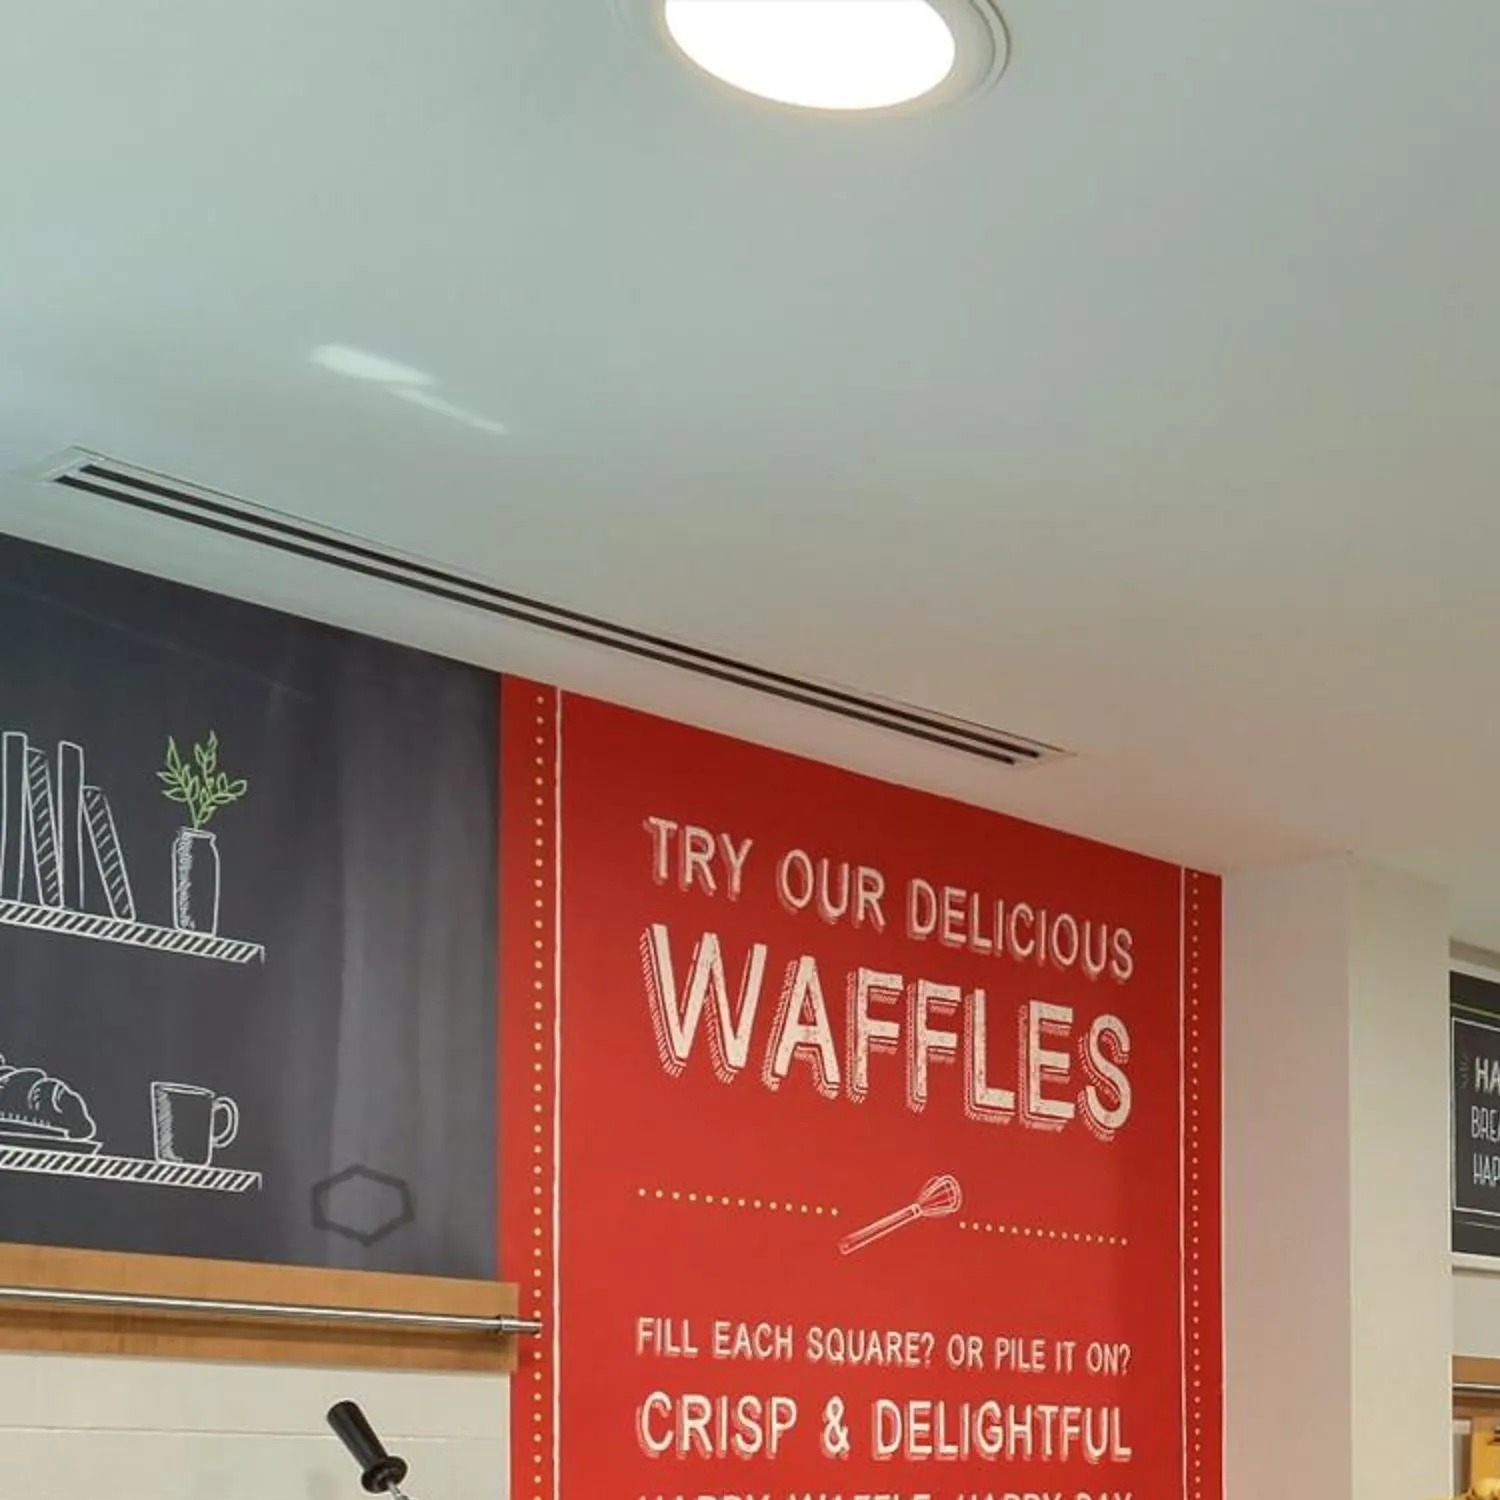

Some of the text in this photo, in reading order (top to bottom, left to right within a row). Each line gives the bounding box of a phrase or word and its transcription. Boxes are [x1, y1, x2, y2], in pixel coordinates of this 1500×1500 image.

[644, 816, 1134, 982] TRY OUR DELICIOUS
[638, 922, 1134, 1142] WAFFLES
[637, 1316, 1131, 1377] FILL EACH SQUARE? OR PILE IT ON?
[636, 1391, 1133, 1464] CRISP & DELIGHTFUL
